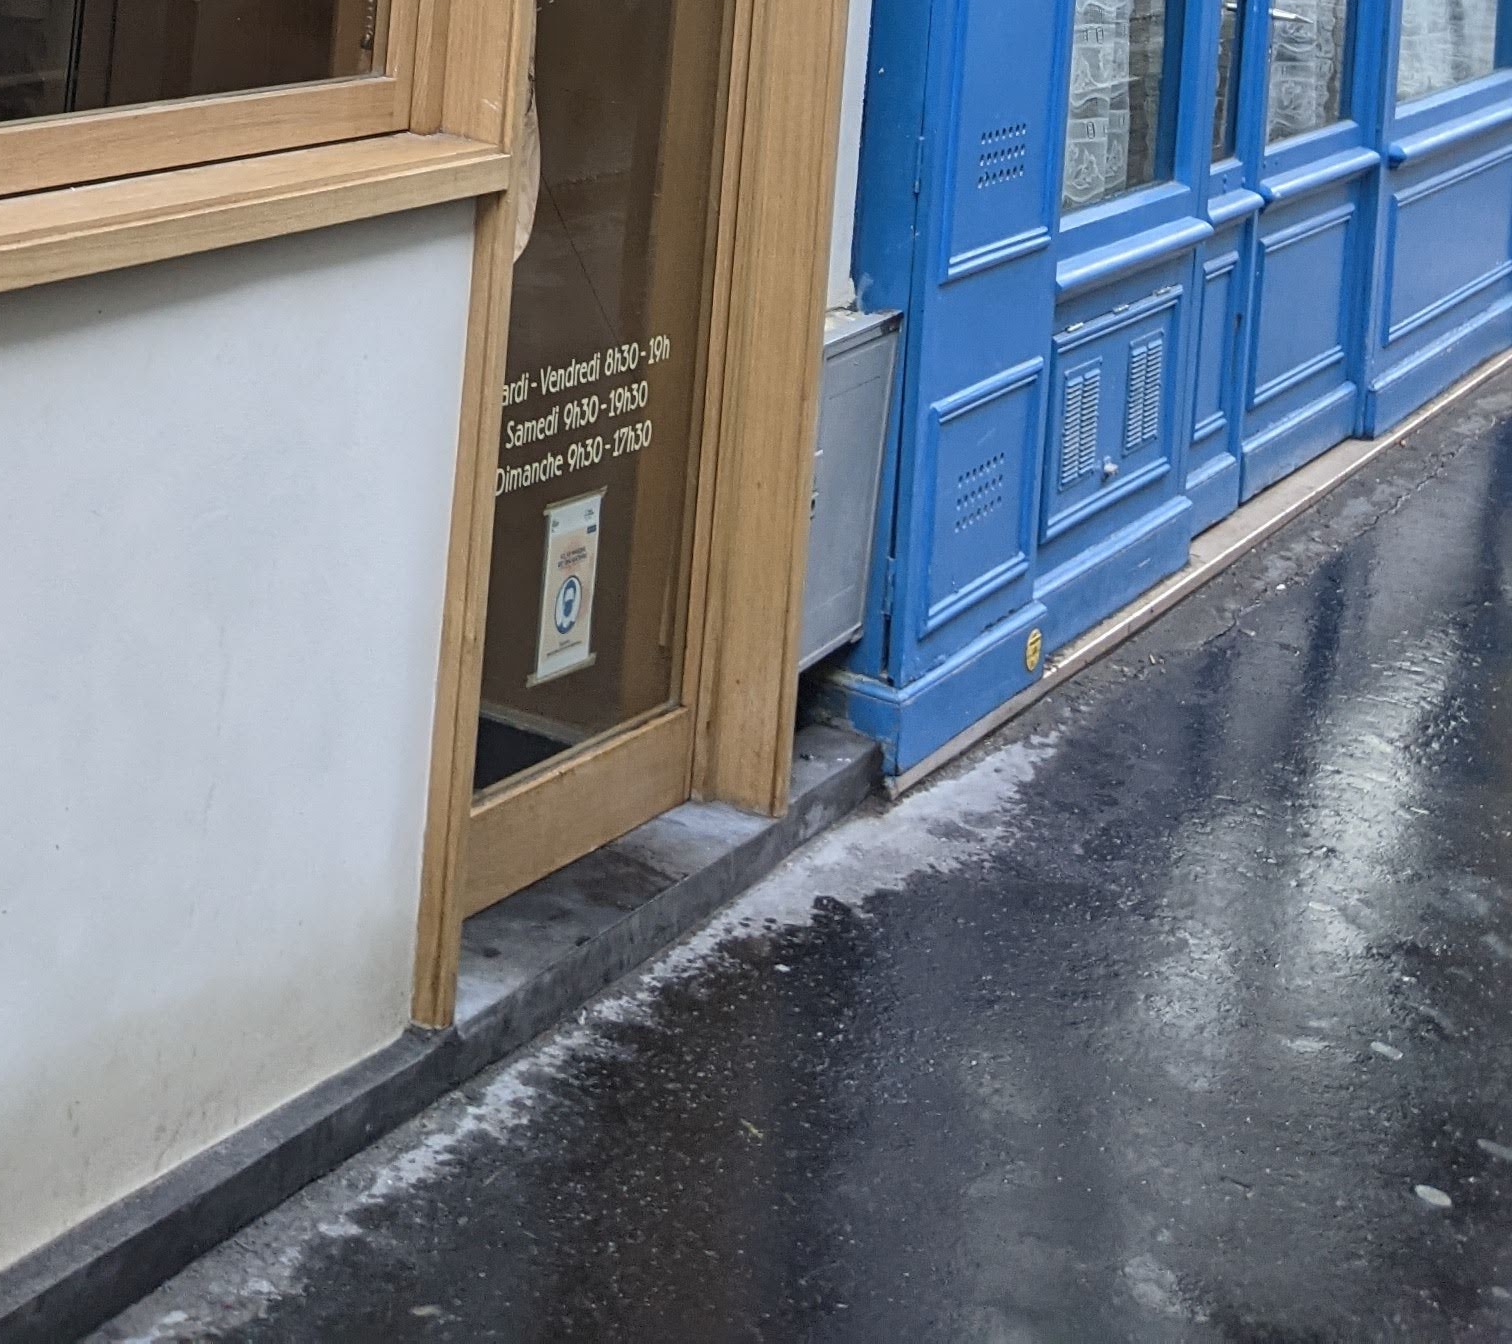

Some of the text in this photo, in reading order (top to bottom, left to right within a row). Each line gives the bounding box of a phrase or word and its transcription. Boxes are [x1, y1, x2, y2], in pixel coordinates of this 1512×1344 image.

[501, 372, 530, 407] ardi
[540, 352, 601, 395] Vendredi
[505, 405, 559, 449] Samedi
[495, 452, 564, 497] Dimanche
